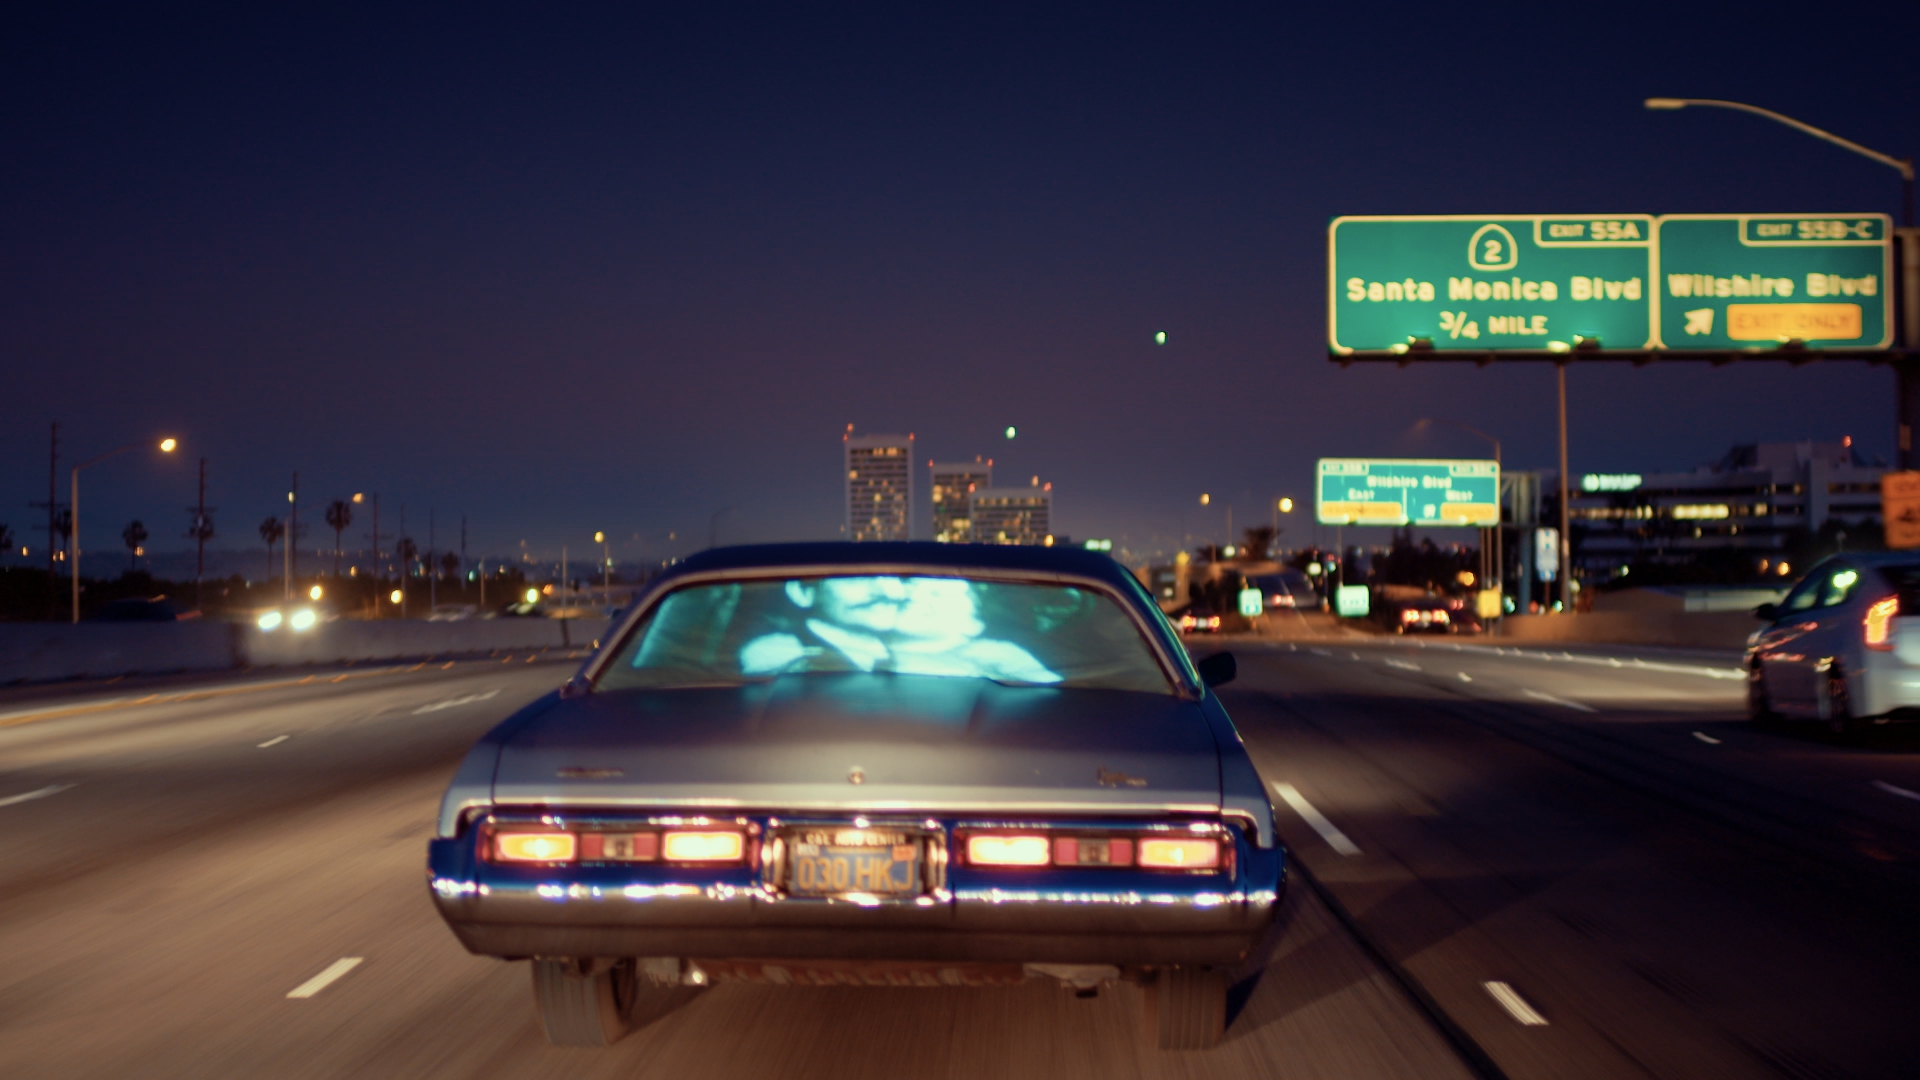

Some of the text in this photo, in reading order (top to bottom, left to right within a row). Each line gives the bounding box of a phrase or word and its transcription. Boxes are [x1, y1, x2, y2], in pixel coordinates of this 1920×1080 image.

[1549, 222, 1640, 239] EXIT 55A
[1757, 223, 1792, 237] EXIT
[1483, 239, 1502, 263] 2
[1347, 276, 1642, 302] Santa Monica Blvd
[1668, 273, 1877, 297] Wilshire Blvd
[1488, 315, 1548, 335] MILE
[1736, 312, 1852, 329] EXIT ONLY
[798, 855, 914, 892] 030 HKJ
